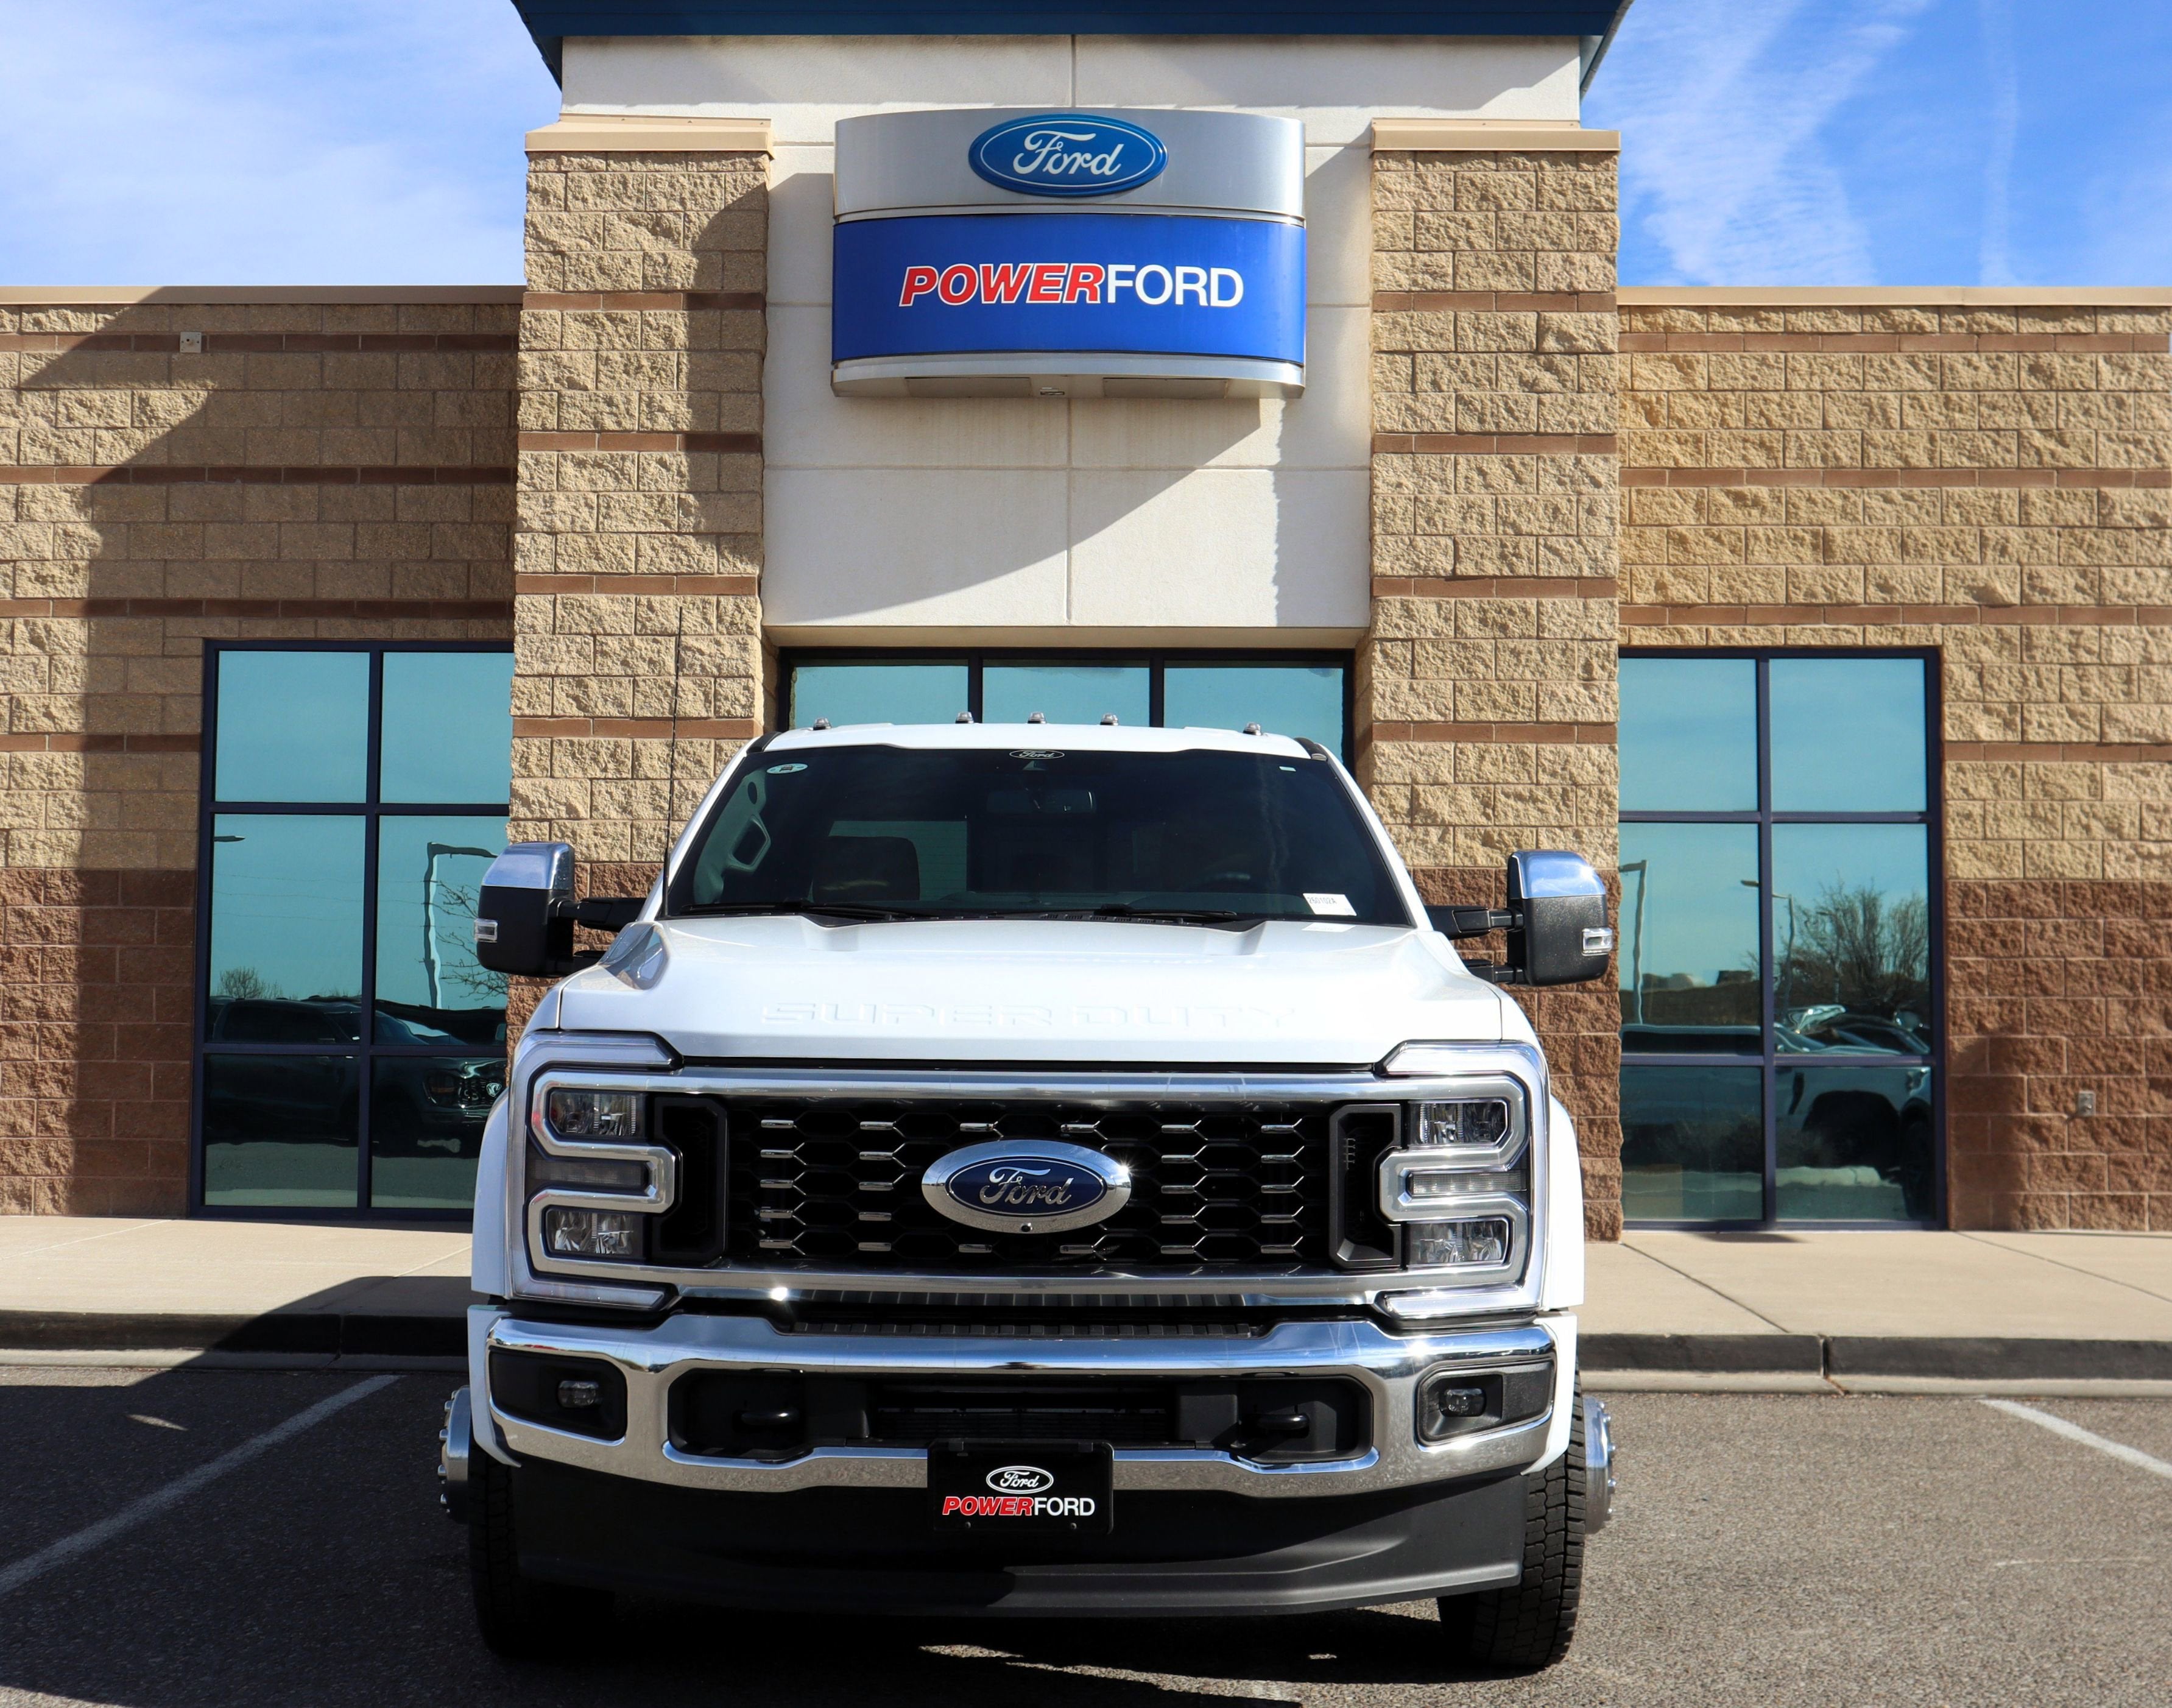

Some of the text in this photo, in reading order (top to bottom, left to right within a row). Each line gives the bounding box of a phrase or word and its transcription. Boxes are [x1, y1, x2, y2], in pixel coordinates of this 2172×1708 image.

[1013, 130, 1123, 175] Ford
[763, 1002, 1294, 1028] SUPER DUTY
[979, 1166, 1074, 1204] Ford
[1000, 1471, 1039, 1487] Ford
